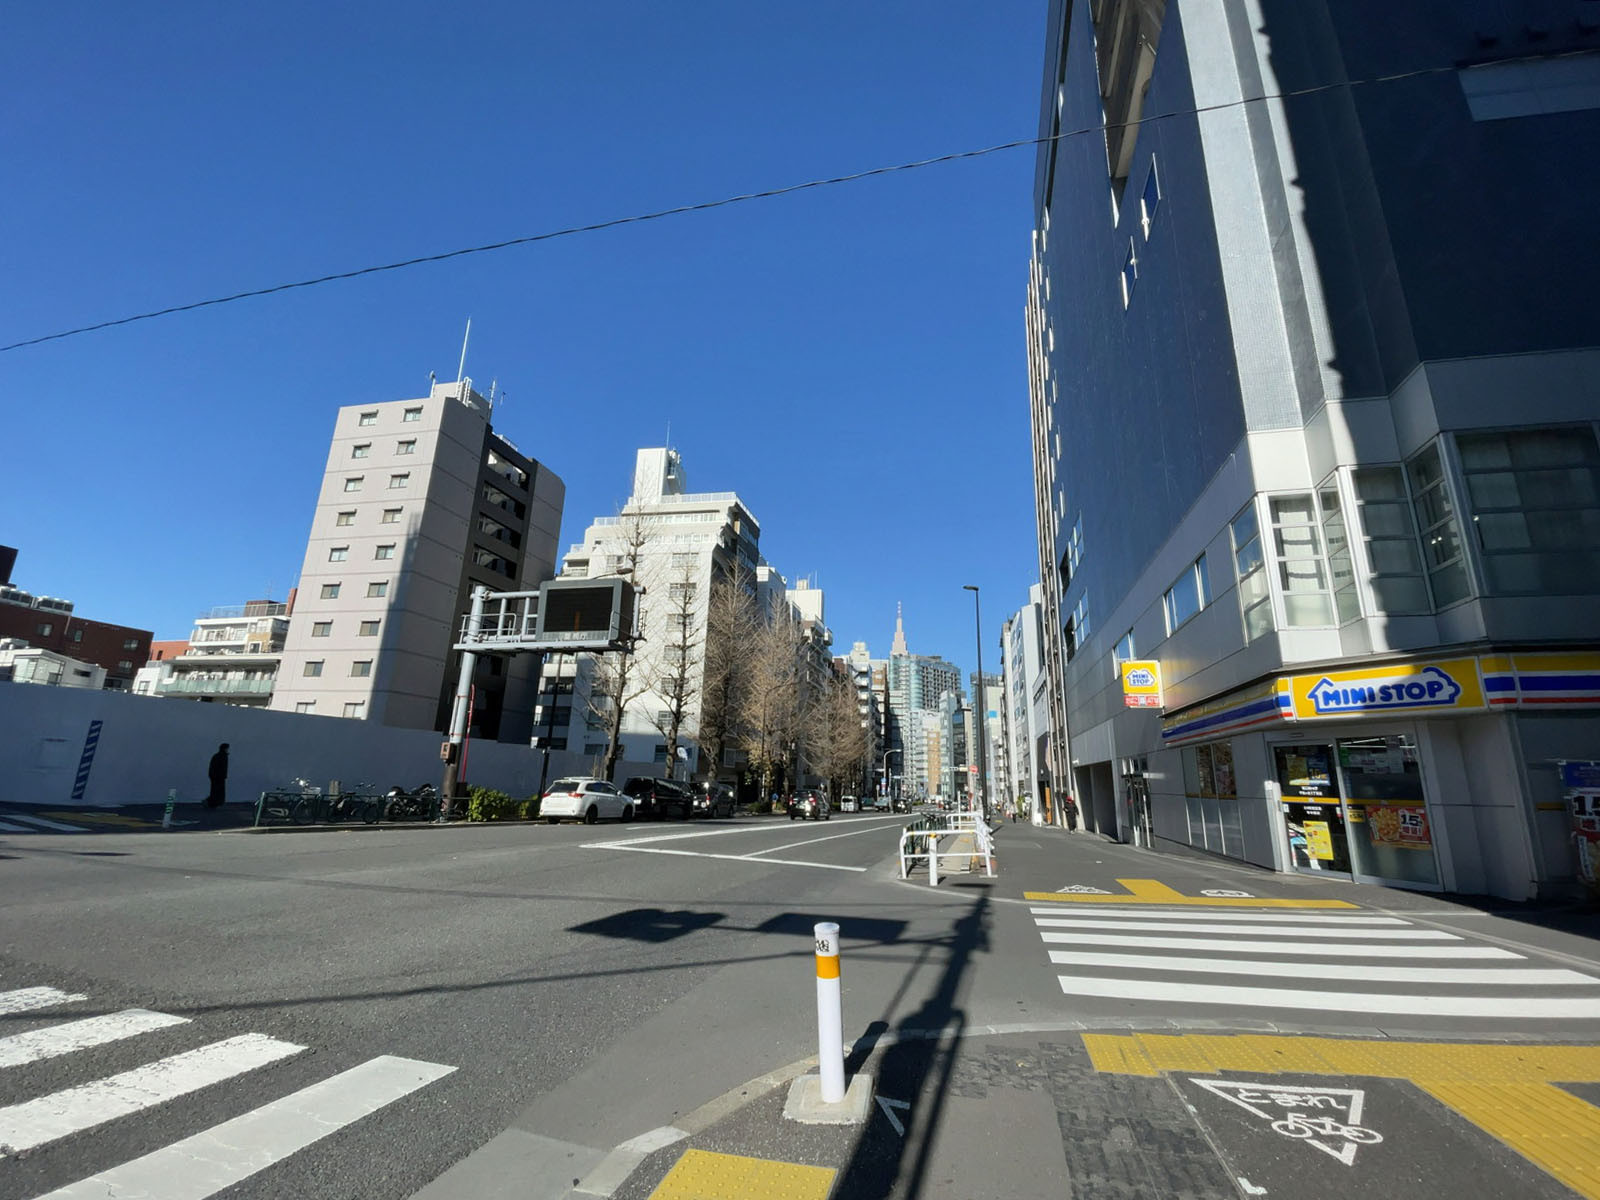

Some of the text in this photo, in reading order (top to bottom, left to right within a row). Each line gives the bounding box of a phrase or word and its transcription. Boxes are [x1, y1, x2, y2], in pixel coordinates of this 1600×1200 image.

[1322, 681, 1444, 706] MINI STOP
[1237, 1088, 1347, 1109] とまれ
